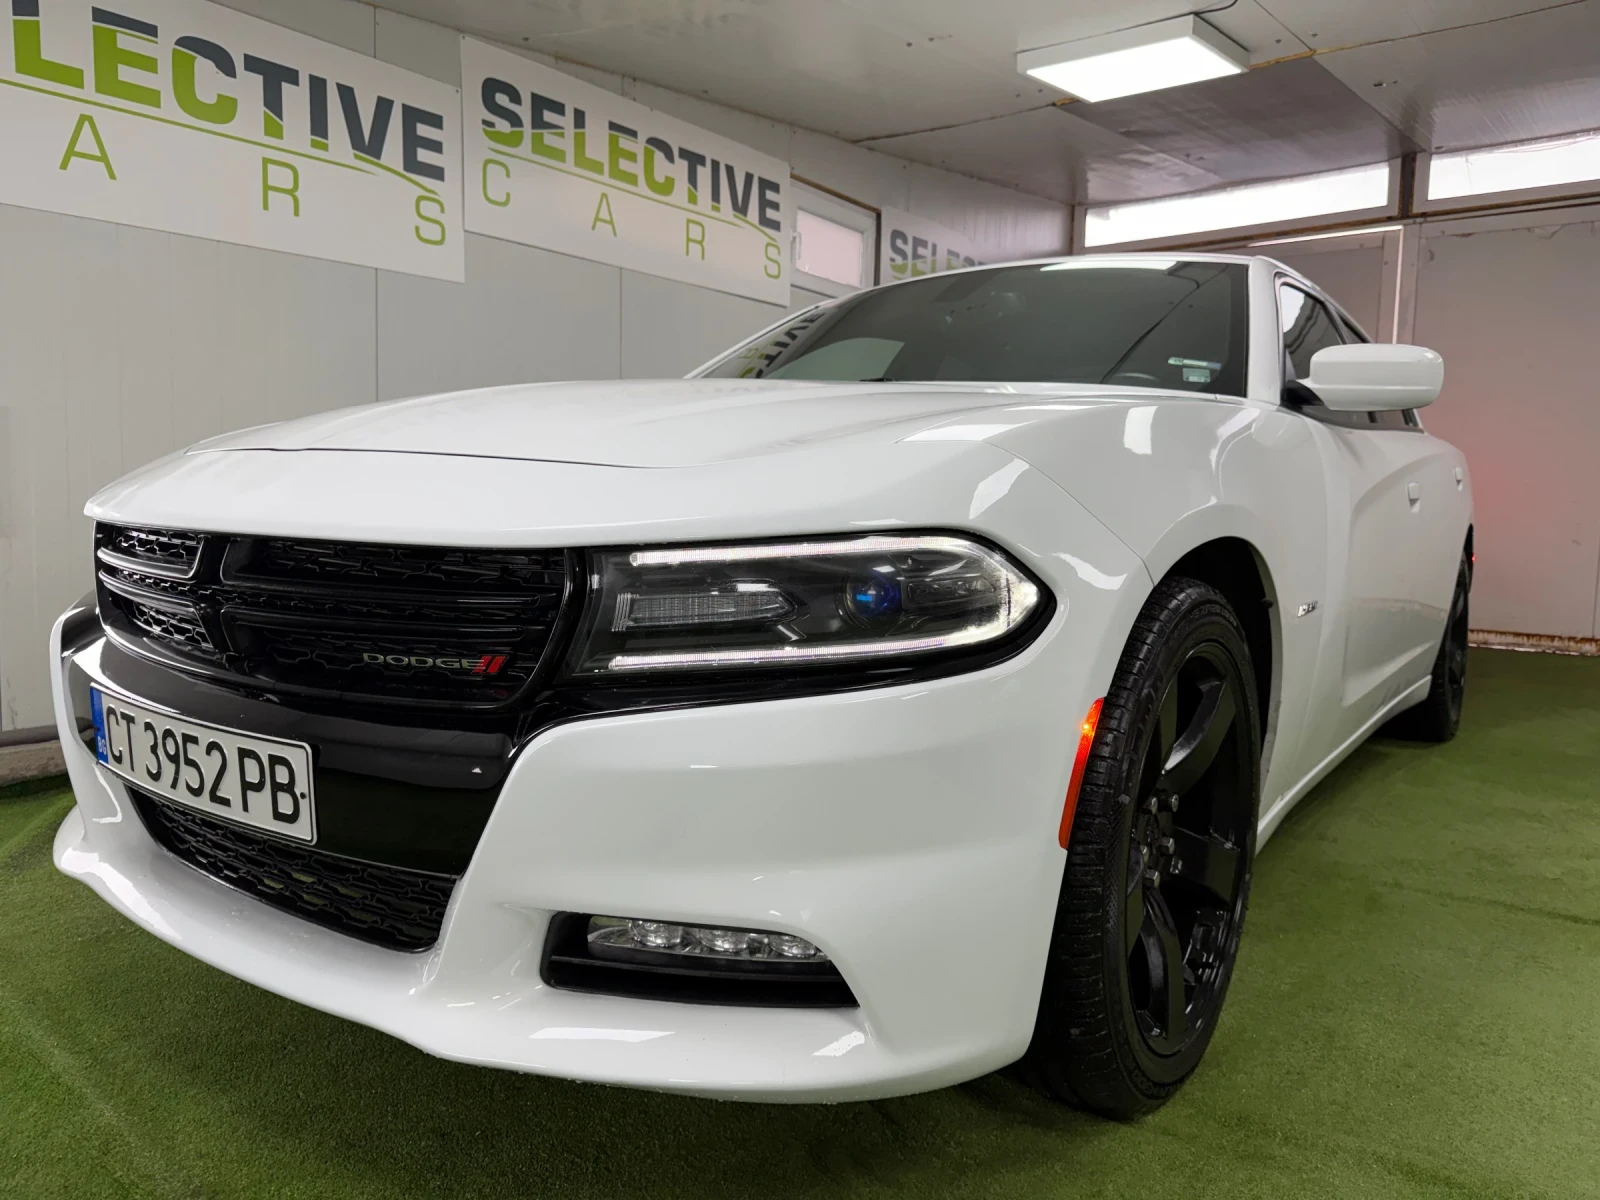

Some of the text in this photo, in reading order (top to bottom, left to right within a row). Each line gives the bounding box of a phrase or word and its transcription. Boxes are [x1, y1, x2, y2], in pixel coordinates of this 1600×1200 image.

[12, 0, 446, 183] LECTIVE
[481, 77, 781, 232] SELECTIVE
[363, 652, 486, 669] DODGE
[106, 704, 301, 824] CT 3952 PB
